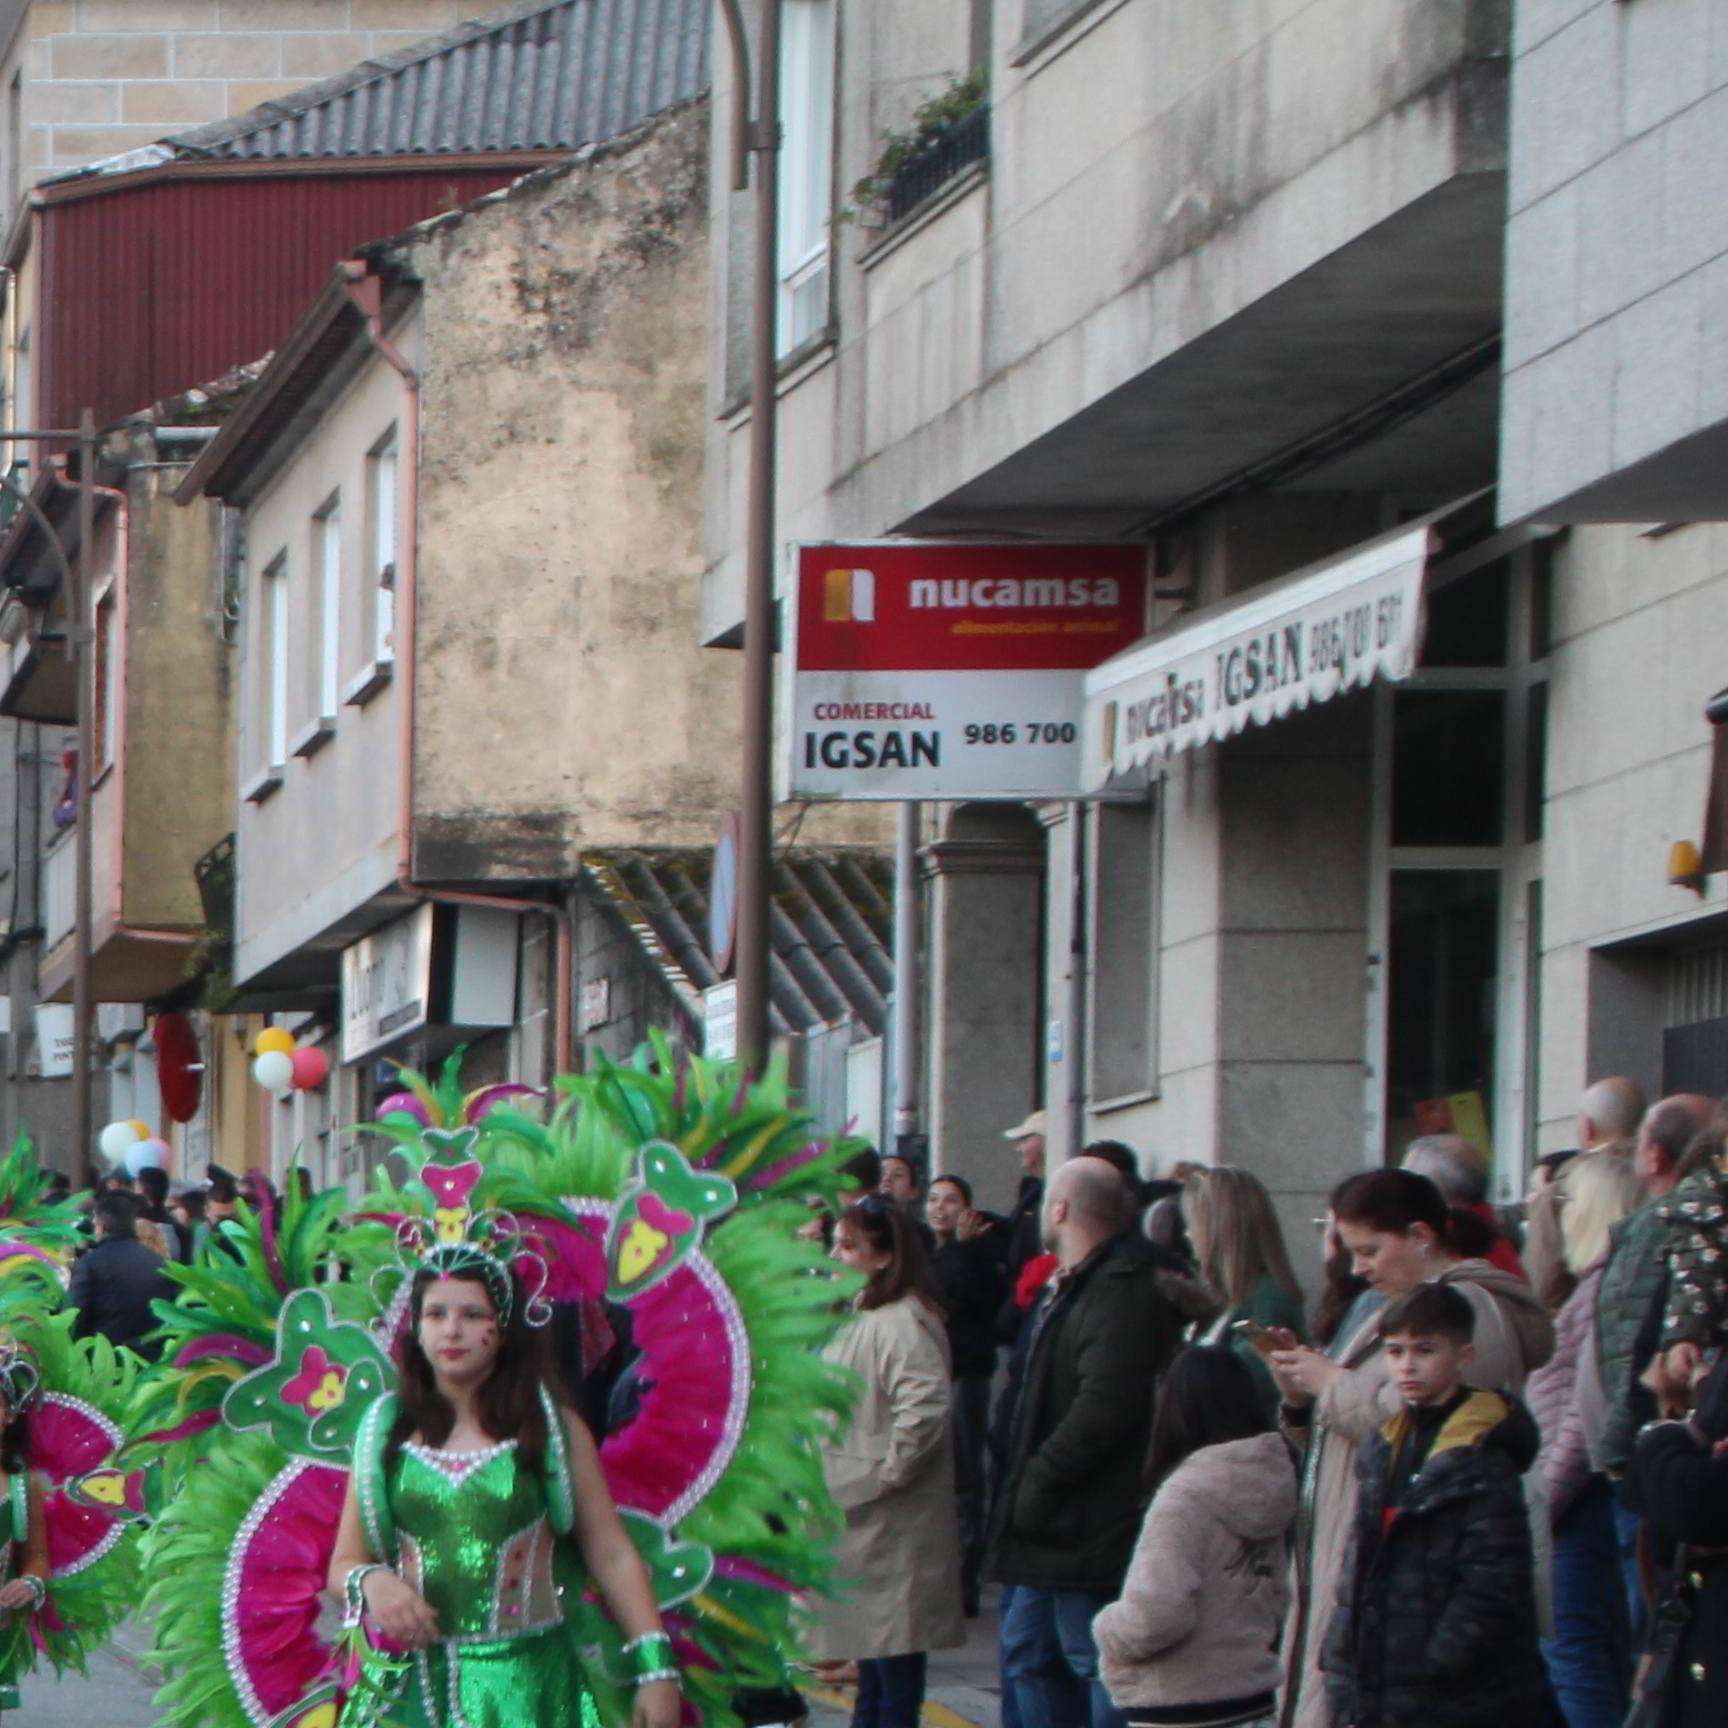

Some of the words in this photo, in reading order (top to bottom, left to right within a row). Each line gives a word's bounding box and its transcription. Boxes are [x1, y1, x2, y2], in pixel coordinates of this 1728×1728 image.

[909, 577, 1120, 608] nucamsa
[814, 702, 936, 721] COMERCIAL
[964, 722, 1016, 745] 986
[1026, 722, 1076, 744] 700
[804, 731, 941, 769] IGSAN
